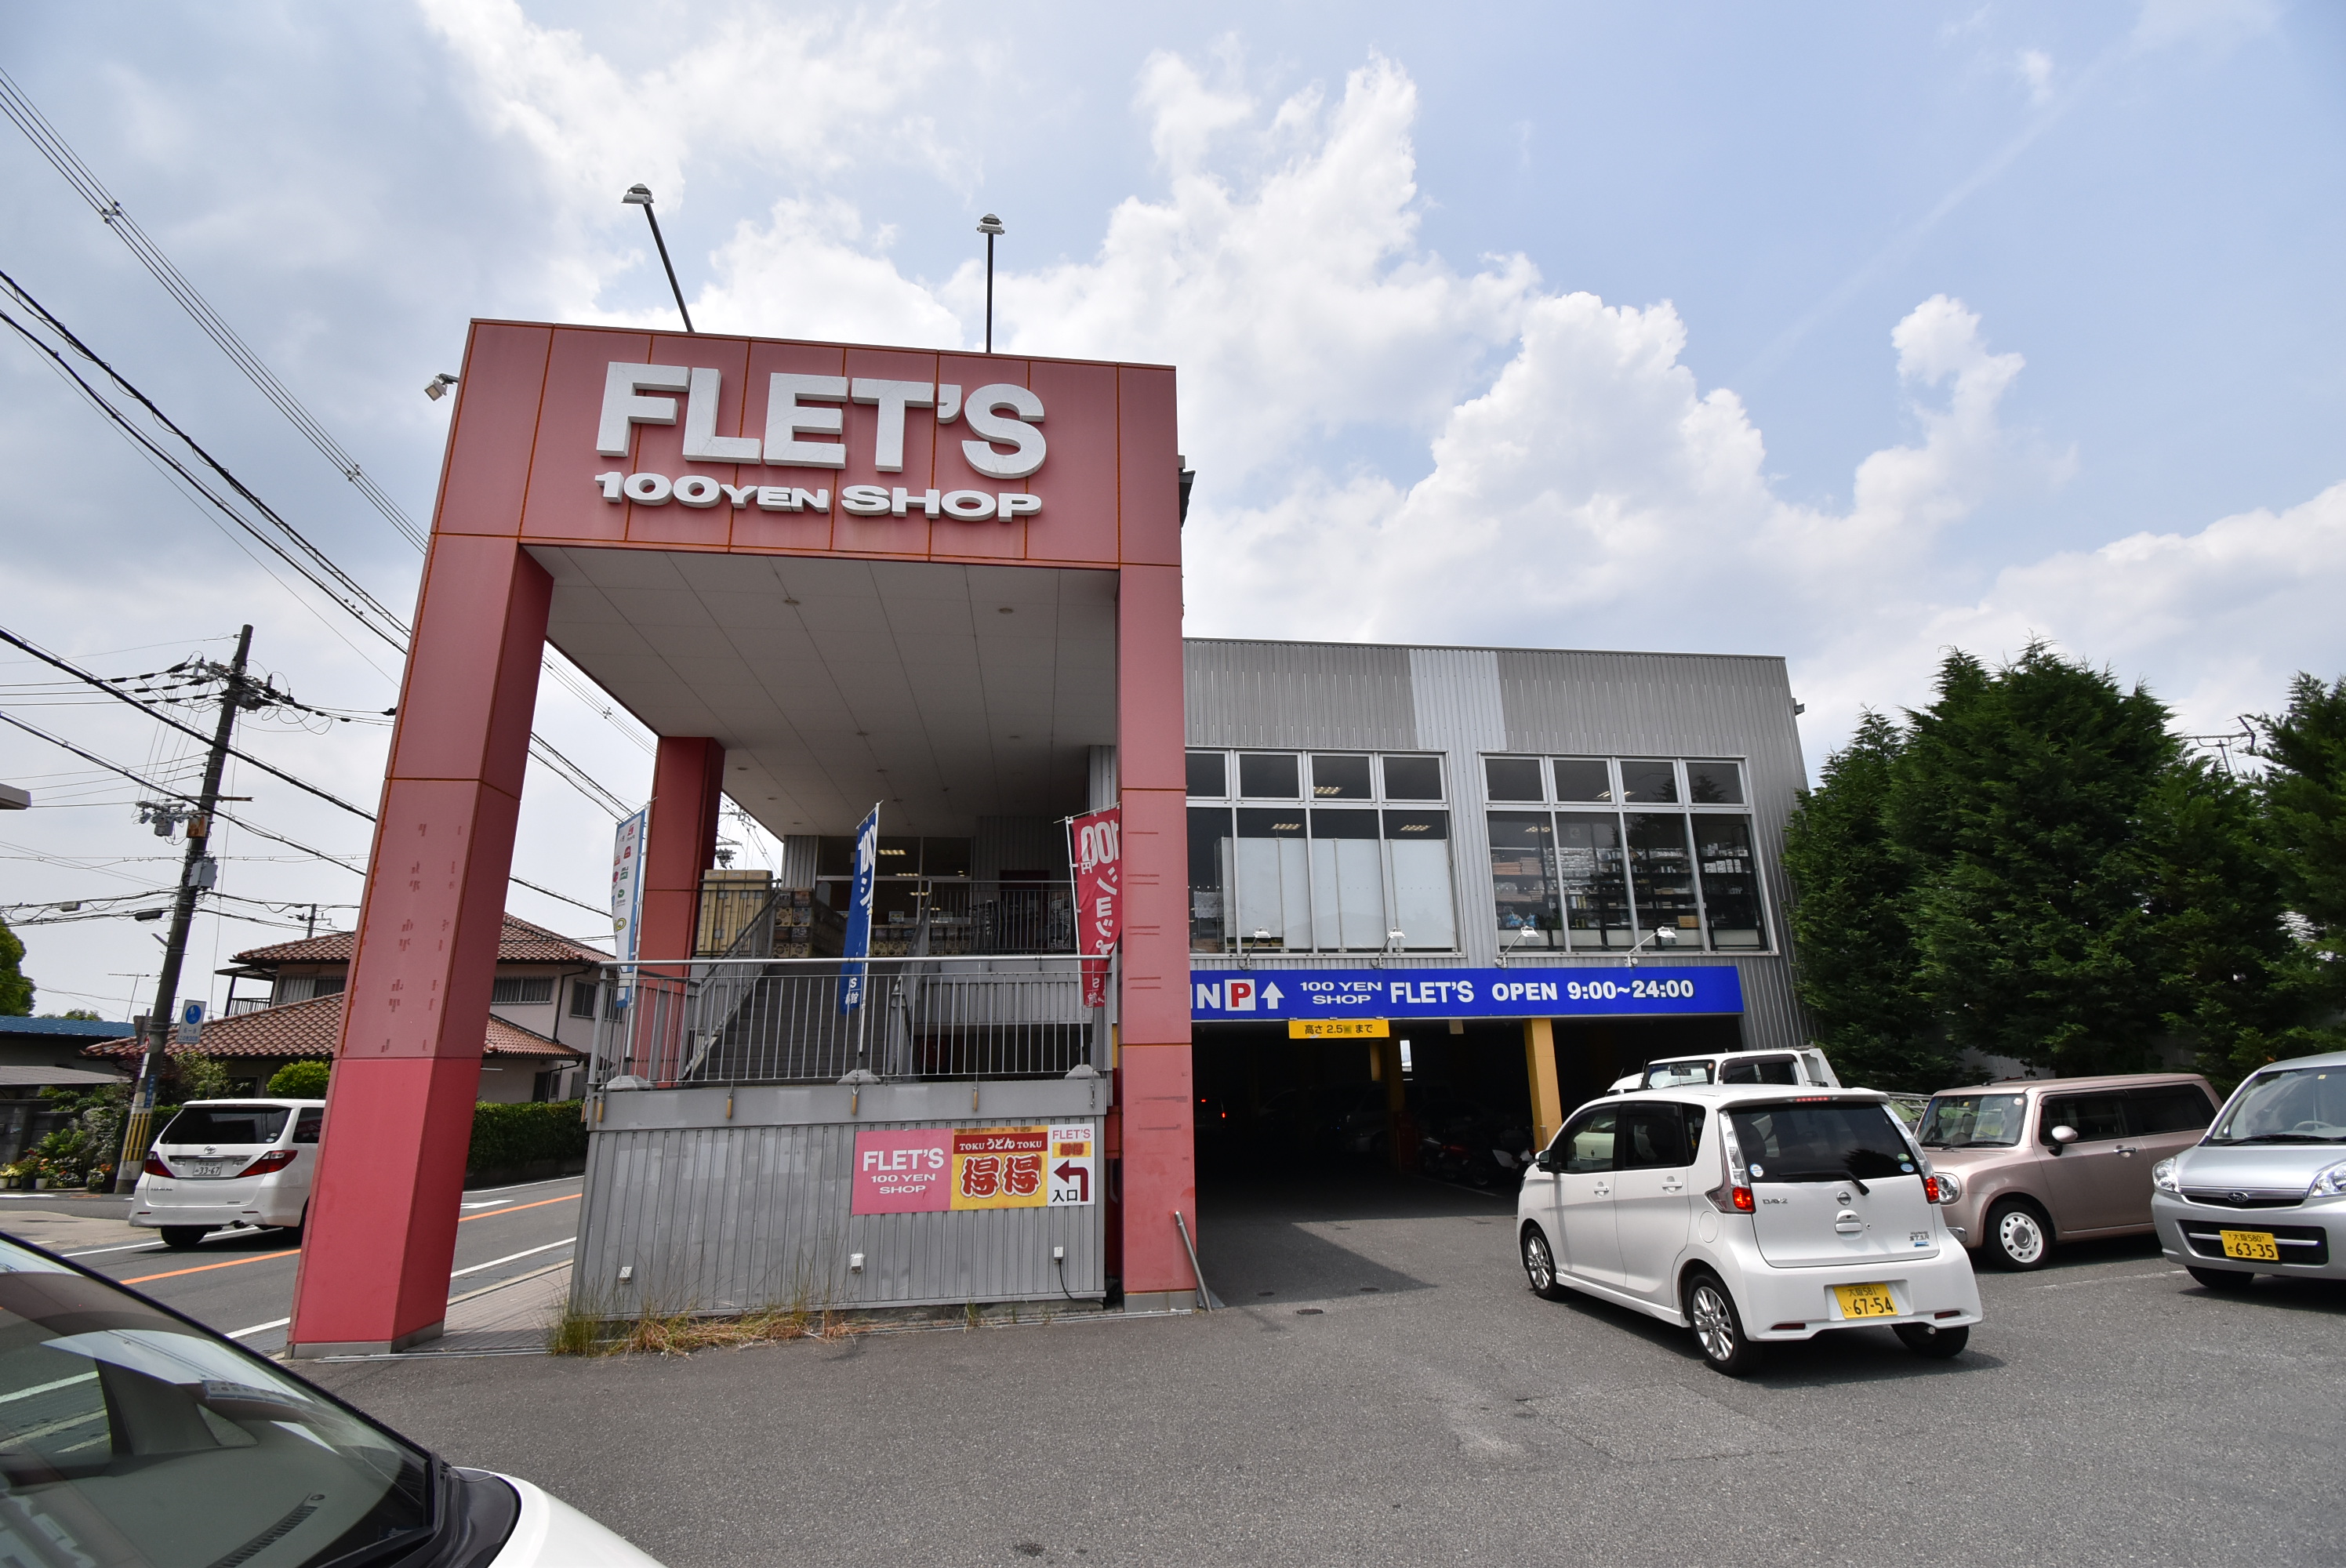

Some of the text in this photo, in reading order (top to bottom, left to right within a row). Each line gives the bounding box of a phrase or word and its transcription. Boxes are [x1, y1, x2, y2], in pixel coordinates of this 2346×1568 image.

[596, 361, 1046, 479] FLET'S
[841, 485, 1042, 523] SHOP
[1299, 982, 1382, 992] 100 YEN
[1390, 981, 1475, 1004] FLET'S
[1492, 982, 1558, 1001] OPEN
[1312, 995, 1371, 1004] SHOP
[1052, 1129, 1091, 1140] FLET'S
[959, 1137, 1042, 1151] TOKU うどん TOKU
[862, 1148, 944, 1171] FLET'S
[871, 1173, 936, 1183] 100 YEN
[879, 1185, 926, 1194] SHOP
[1051, 1189, 1078, 1203] 入口
[2235, 1242, 2275, 1258] 63-35
[1853, 1297, 1894, 1315] 67-54
